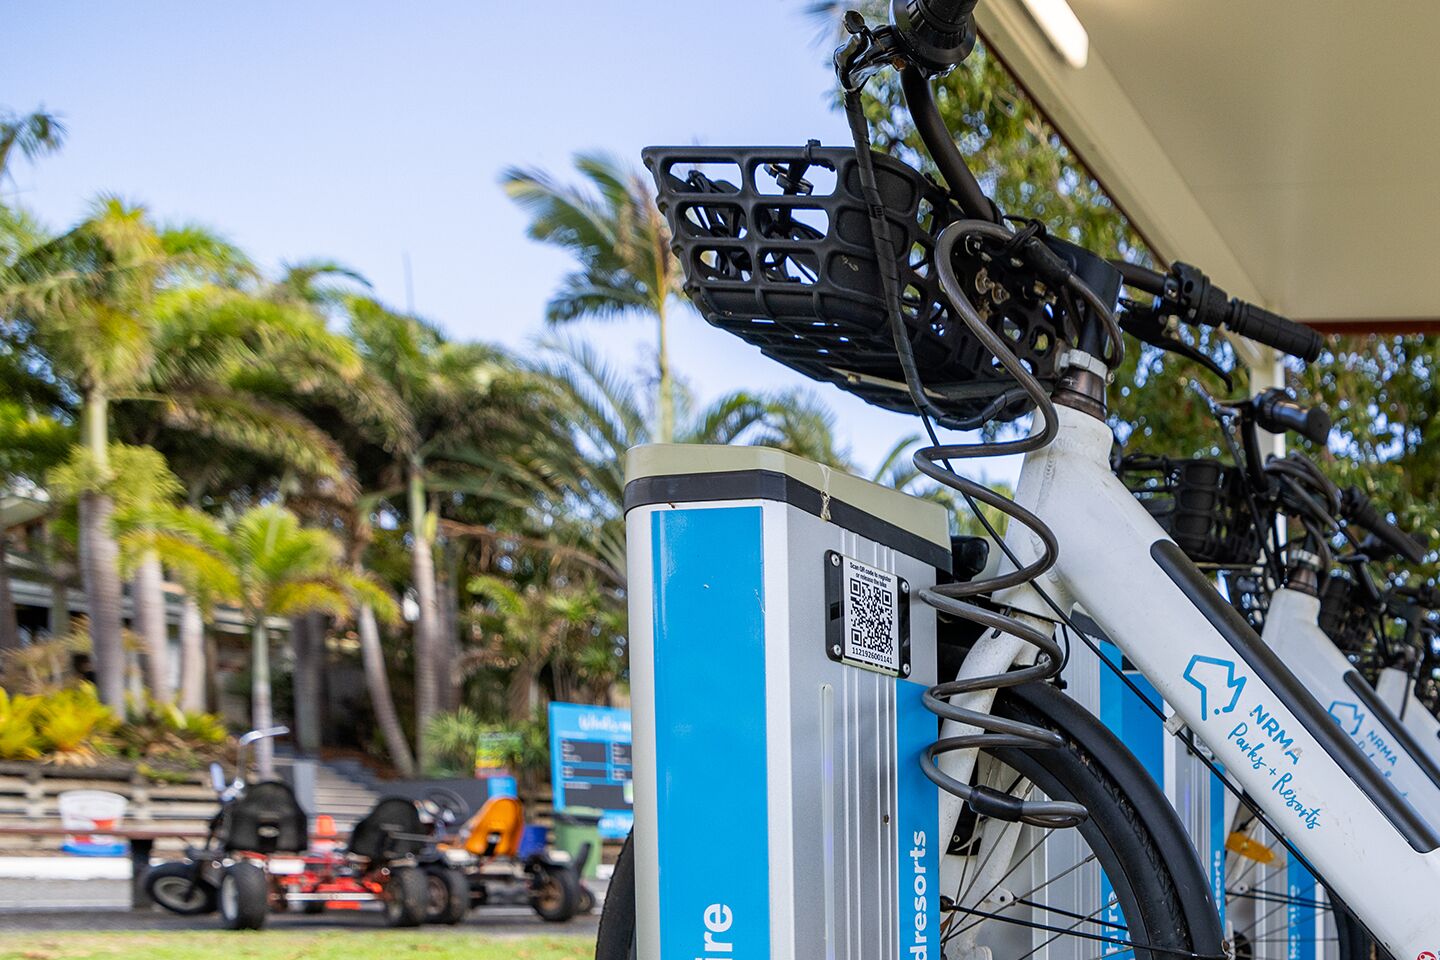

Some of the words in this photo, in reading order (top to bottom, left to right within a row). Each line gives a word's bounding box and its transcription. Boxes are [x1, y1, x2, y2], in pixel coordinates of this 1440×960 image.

[1250, 704, 1301, 766] NRMA
[1366, 730, 1398, 767] NRMA
[1227, 722, 1267, 770] Parks
[1271, 772, 1321, 830] Resorts
